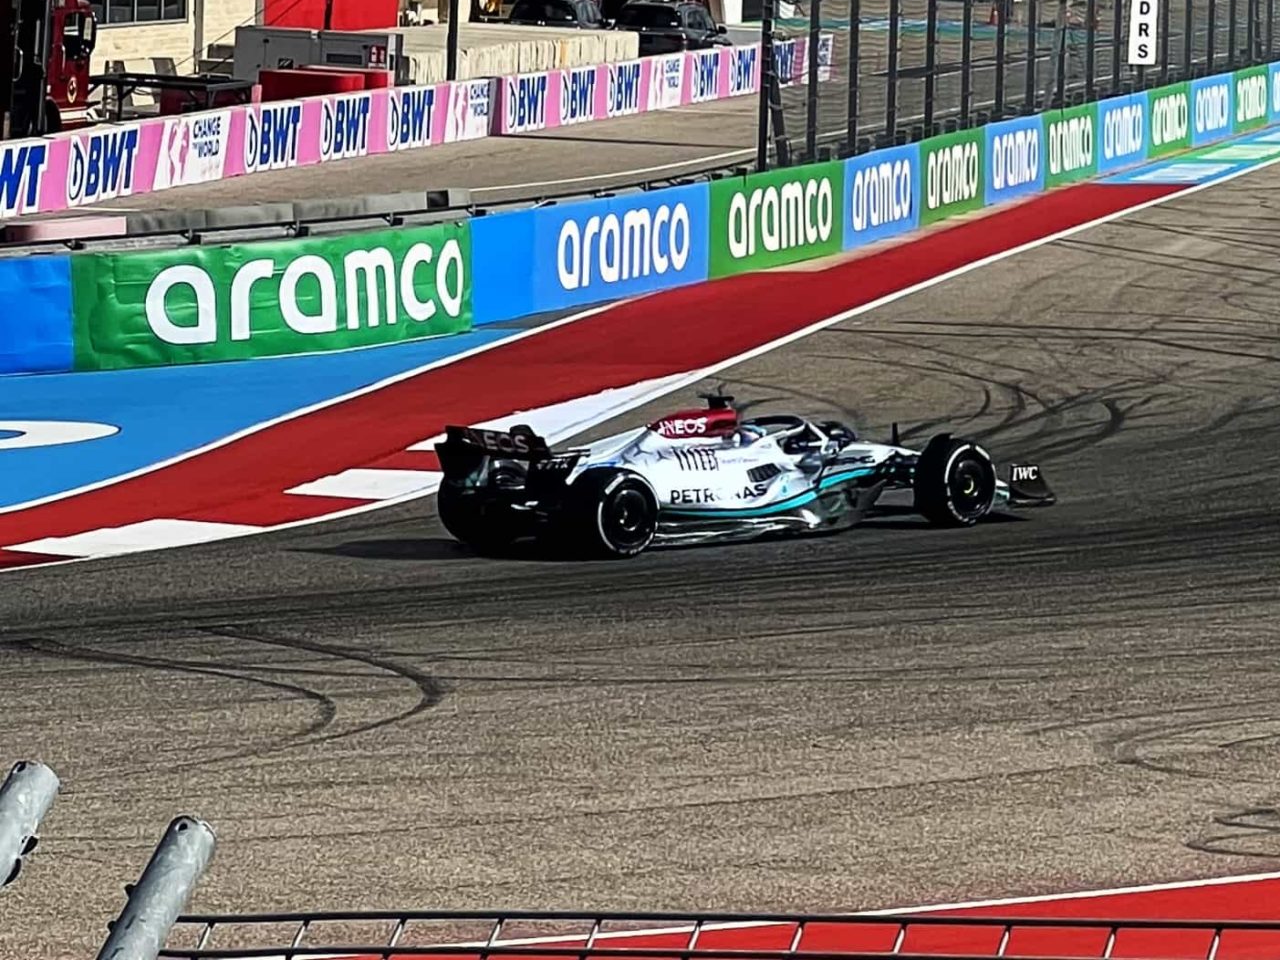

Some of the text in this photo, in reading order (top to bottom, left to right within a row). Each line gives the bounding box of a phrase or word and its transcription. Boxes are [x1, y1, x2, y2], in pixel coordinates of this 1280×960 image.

[570, 69, 596, 118] BWT
[616, 64, 641, 111] BWT
[699, 53, 720, 97] BWT
[737, 47, 756, 91] BWT
[193, 116, 221, 139] CHANGE
[333, 97, 370, 153] BWT
[400, 89, 435, 144] BWT
[517, 76, 547, 127] BWT
[198, 139, 220, 158] WORLD
[260, 106, 301, 165] BWT
[992, 128, 1038, 190] aramco
[1050, 115, 1093, 174] aramco
[1104, 103, 1143, 159] aramco
[85, 129, 139, 197] BWT
[927, 141, 979, 209] aramco
[728, 177, 832, 258] aramco
[852, 159, 911, 232] aramco
[557, 202, 690, 290] aramco
[145, 239, 464, 344] aramco
[670, 483, 768, 505] PETRAS
[1012, 464, 1038, 481] IWC
